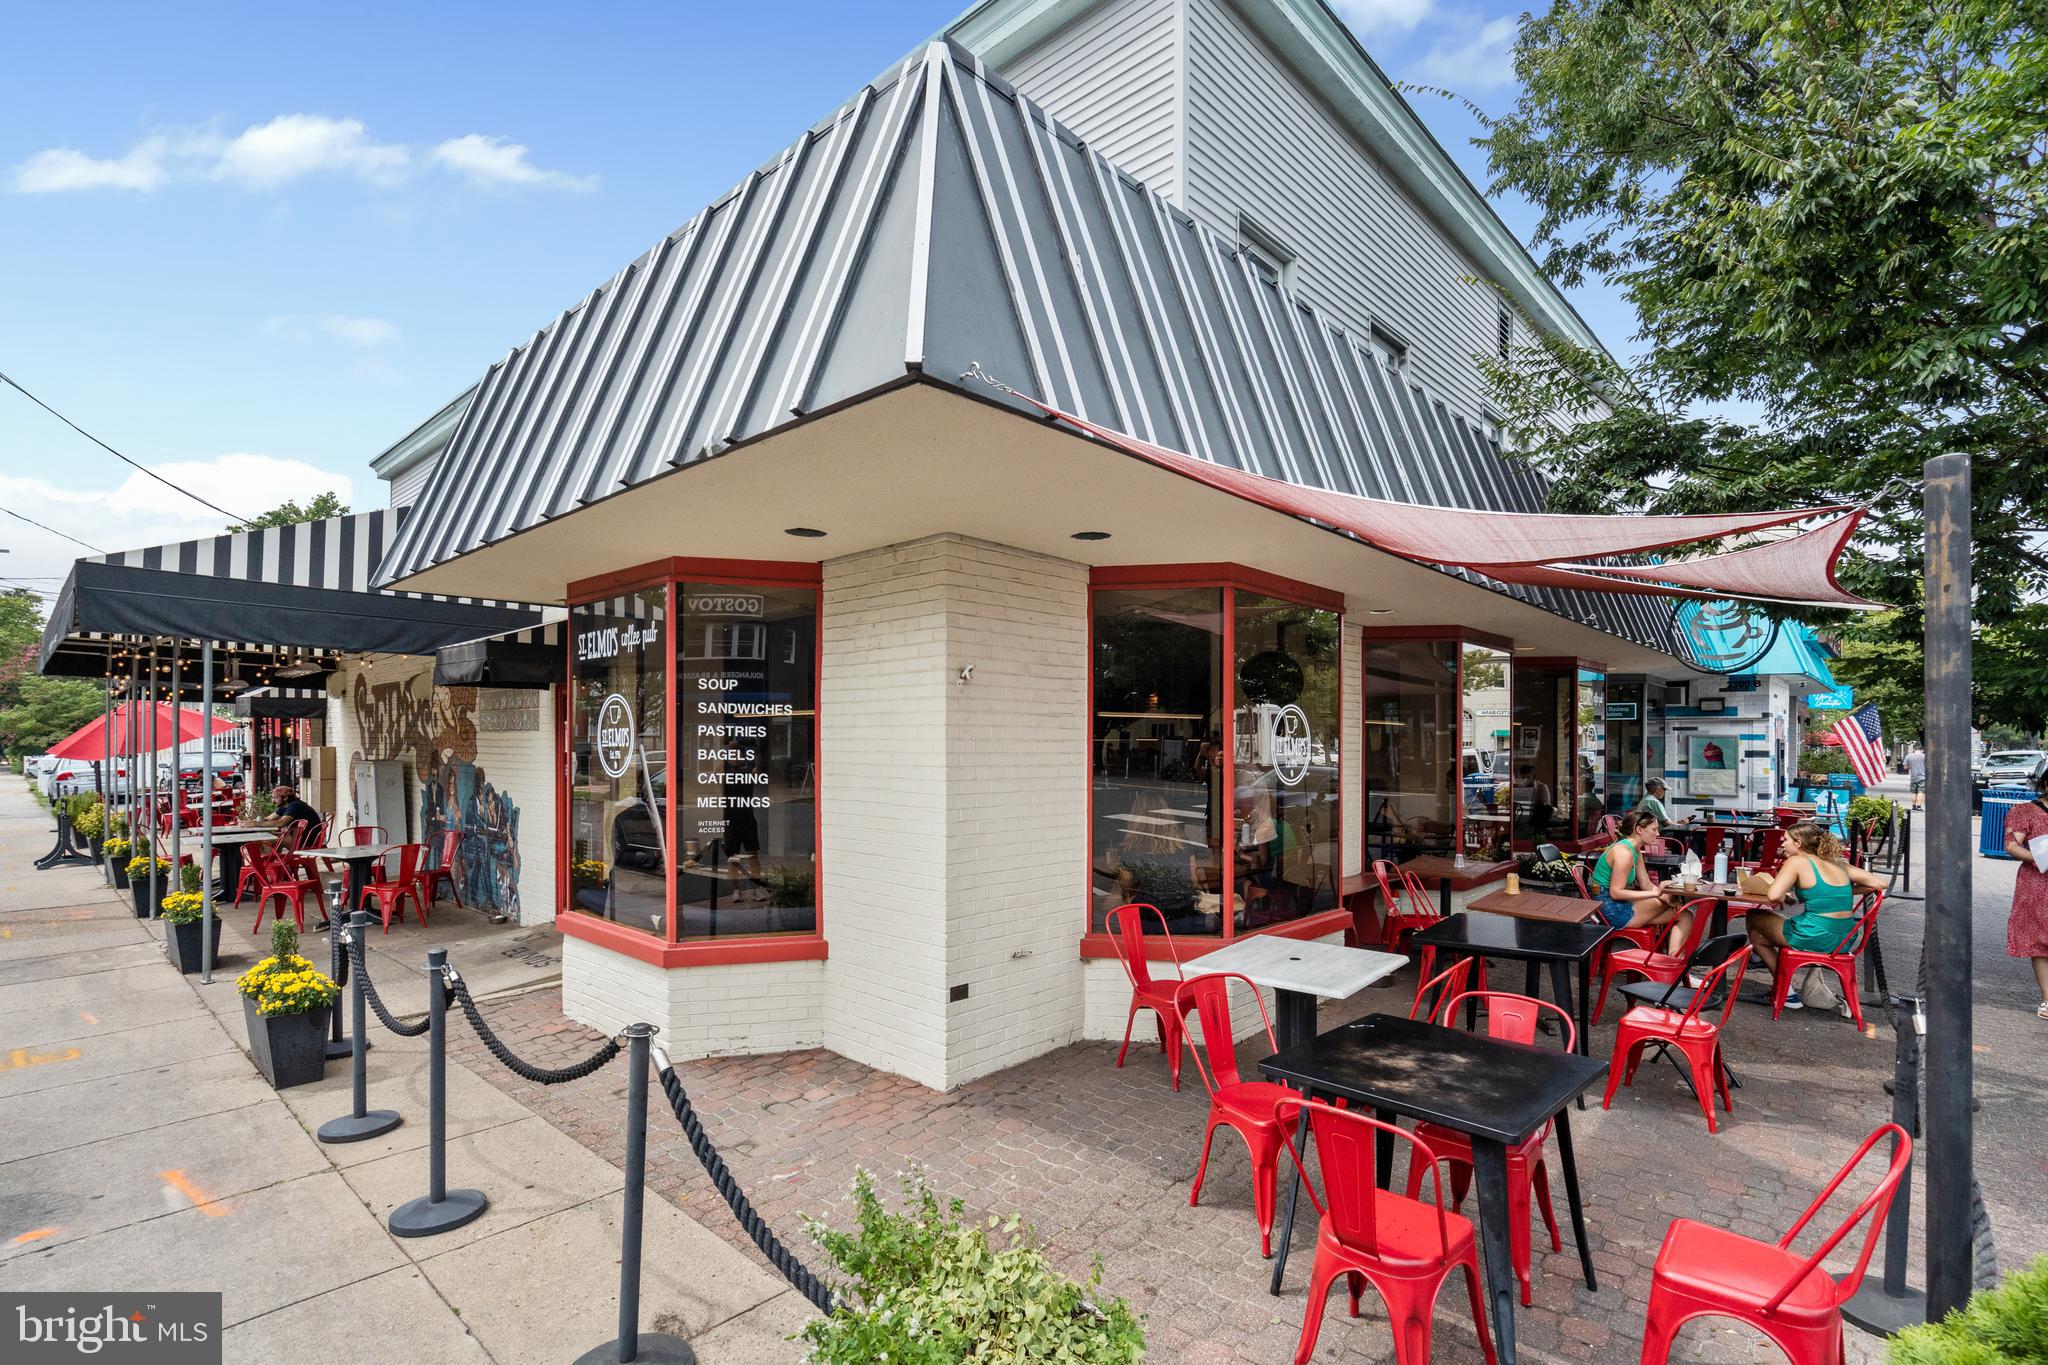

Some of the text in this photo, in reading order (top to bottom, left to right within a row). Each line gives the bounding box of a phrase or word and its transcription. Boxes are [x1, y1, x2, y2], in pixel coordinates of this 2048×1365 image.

[587, 626, 618, 660] ELMO'S
[620, 623, 641, 653] coffee
[642, 620, 658, 650] pub
[698, 678, 739, 690] SOUP
[697, 702, 793, 715] SANDWICHES
[697, 725, 767, 737] PASTRIES
[608, 728, 629, 747] ELMO'S
[697, 749, 755, 761] BAGELS
[697, 773, 769, 784] CATERING
[697, 796, 771, 808] MEETINGS
